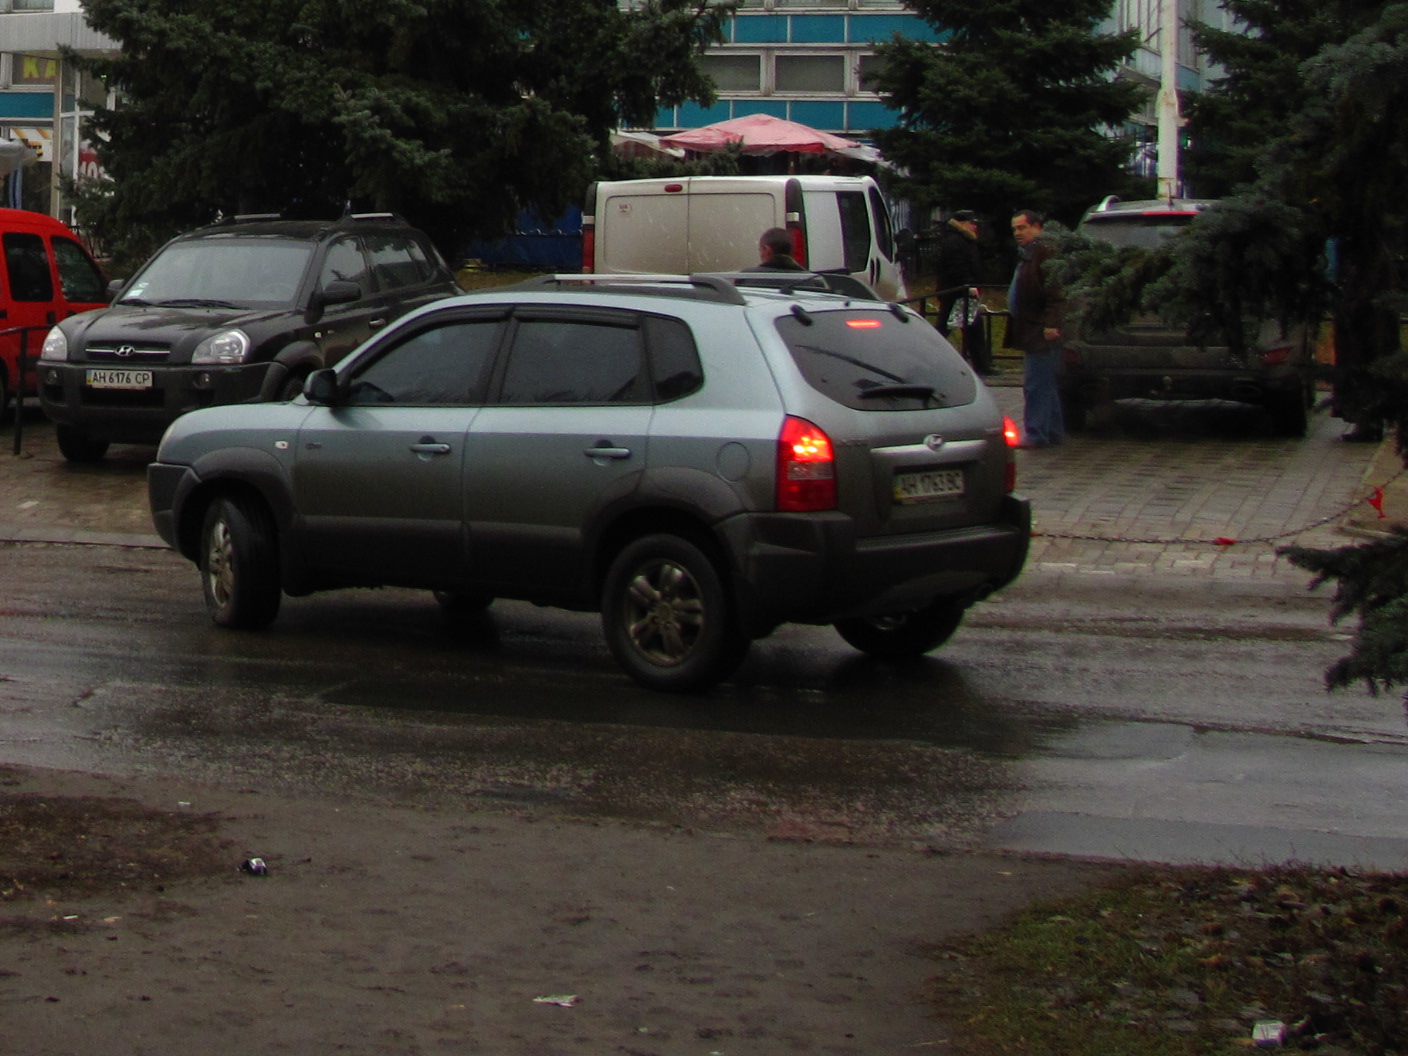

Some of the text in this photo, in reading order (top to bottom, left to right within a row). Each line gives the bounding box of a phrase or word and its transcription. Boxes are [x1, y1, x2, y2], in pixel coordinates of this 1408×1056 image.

[92, 371, 150, 384] AH 6176 CP
